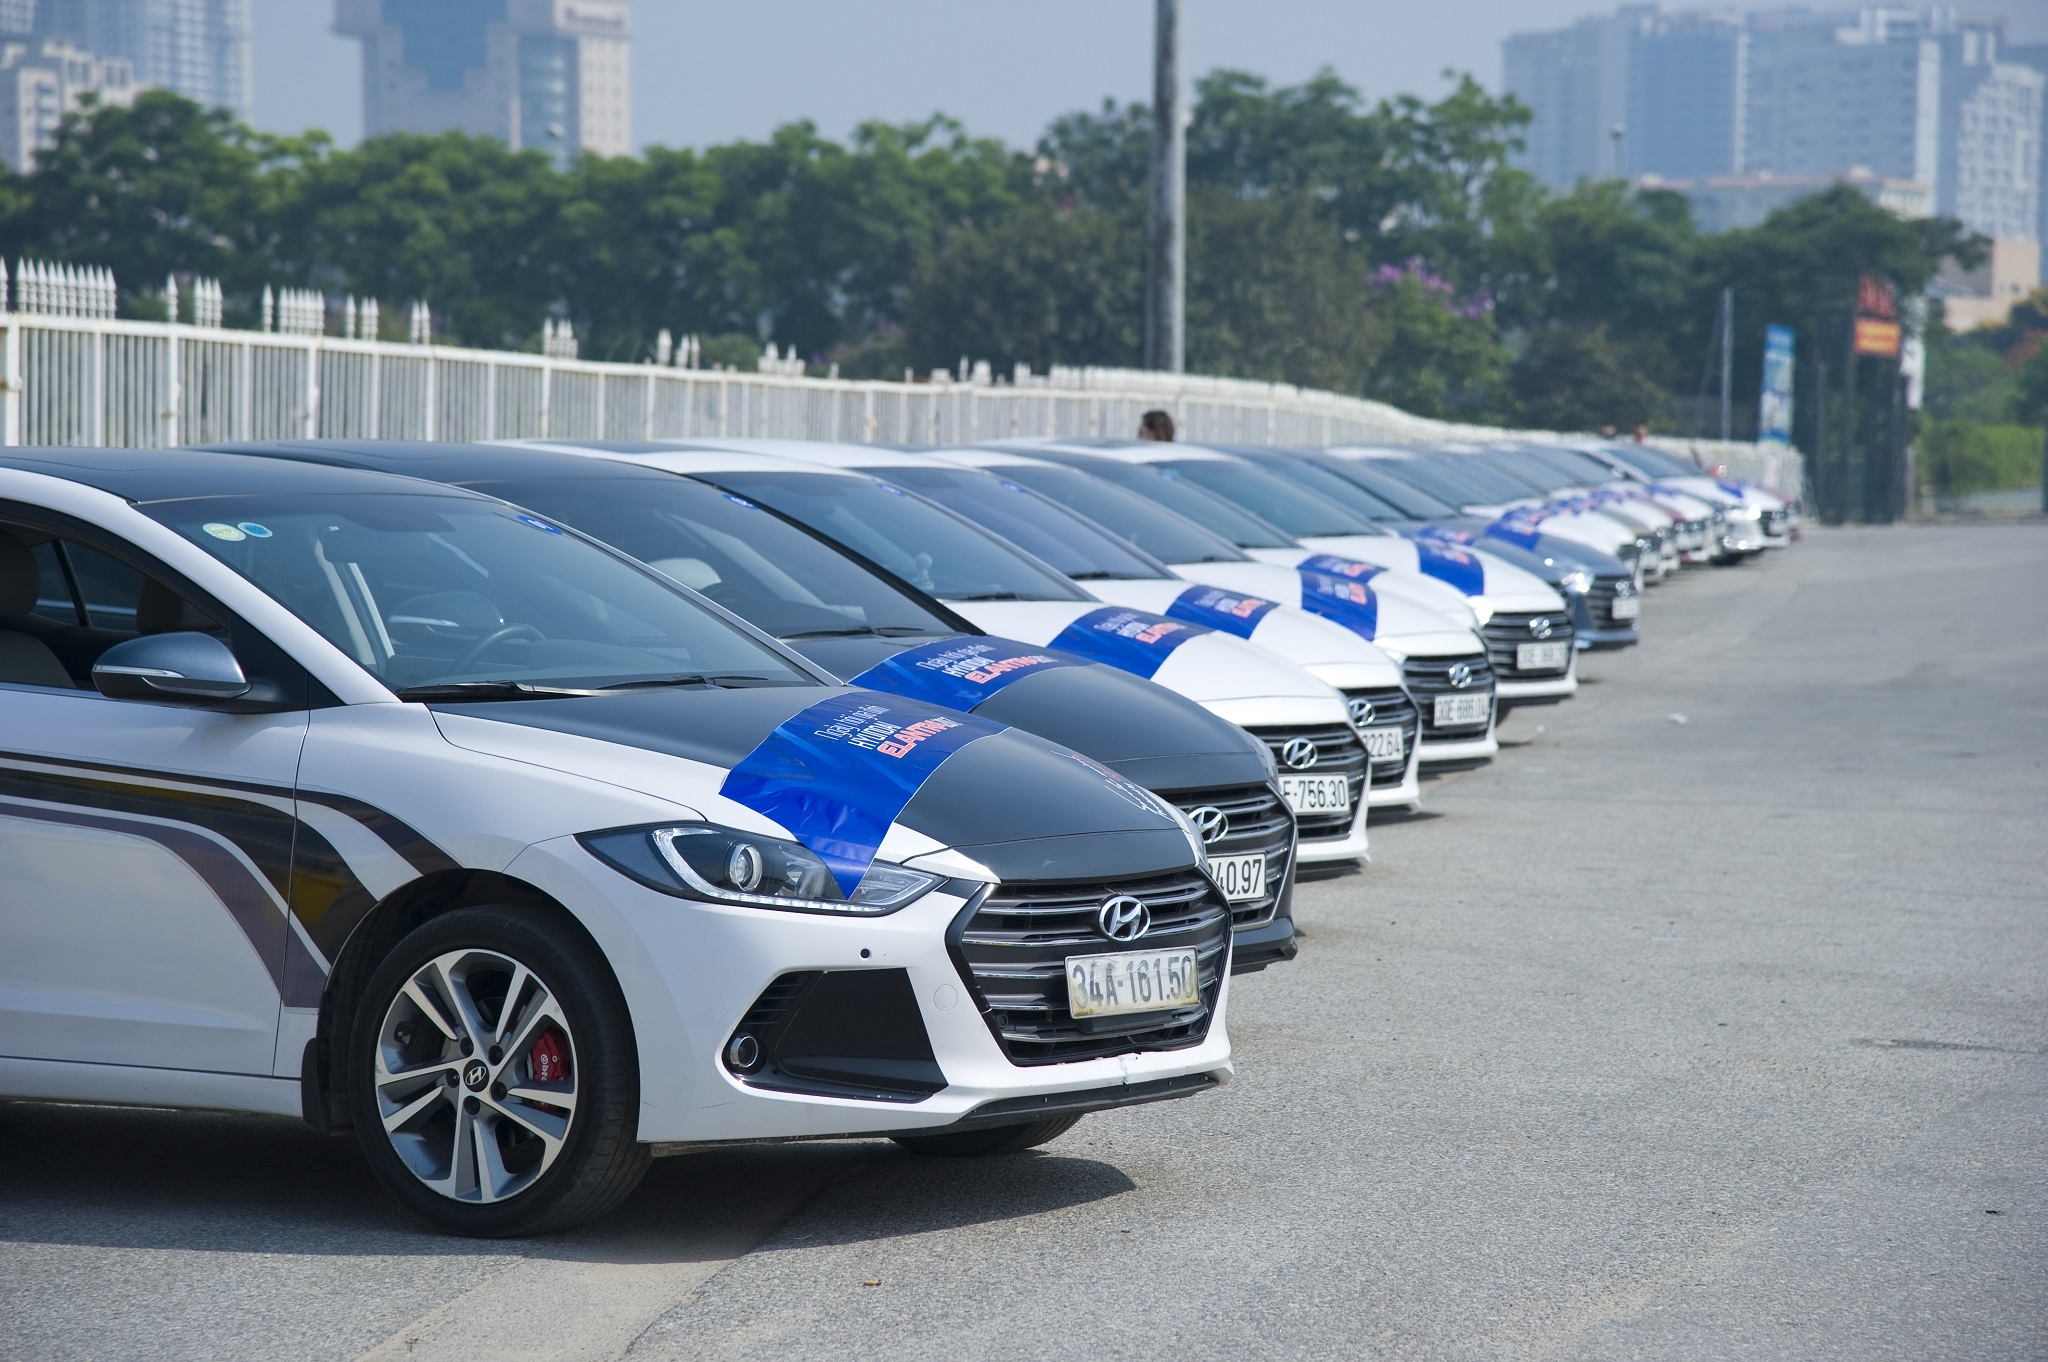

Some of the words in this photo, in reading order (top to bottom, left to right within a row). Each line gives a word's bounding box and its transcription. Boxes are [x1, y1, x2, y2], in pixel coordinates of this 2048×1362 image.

[876, 718, 948, 759] ELANTRA
[1208, 858, 1263, 896] 40.97
[1072, 955, 1195, 1009] 34A-161.50
